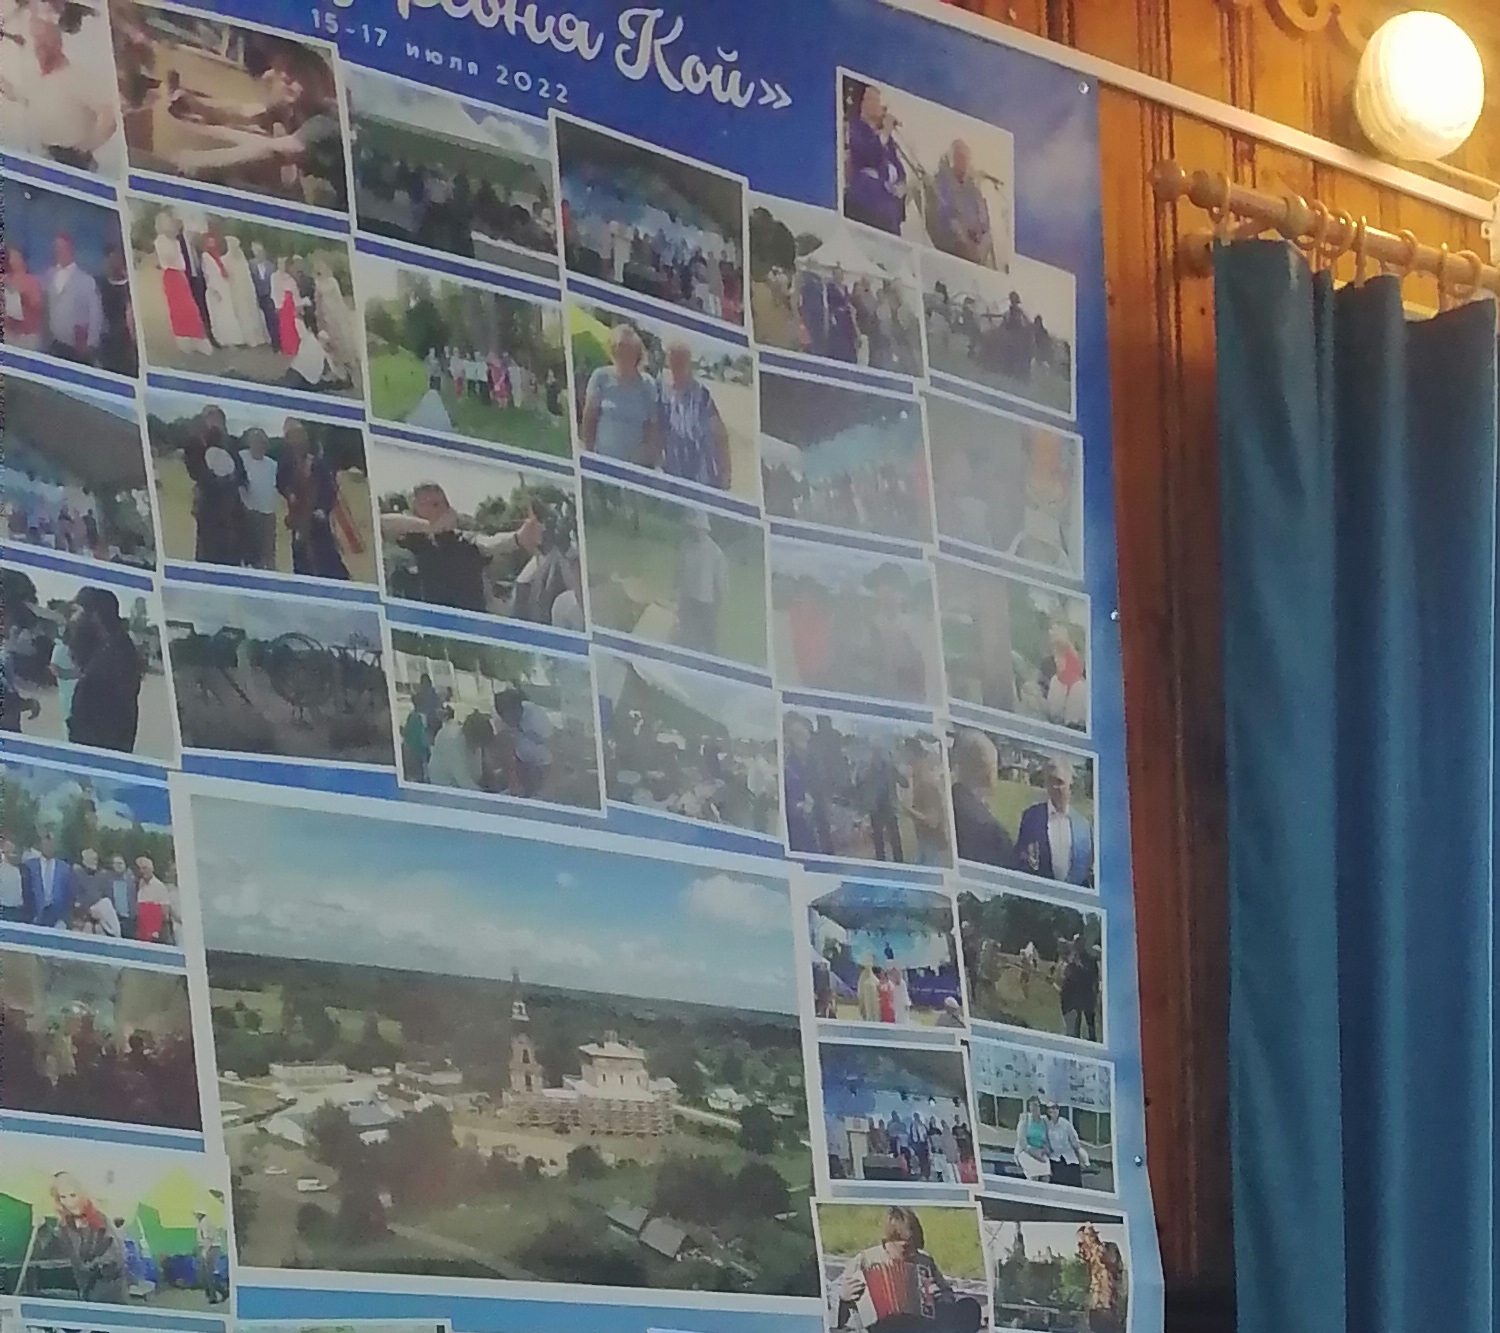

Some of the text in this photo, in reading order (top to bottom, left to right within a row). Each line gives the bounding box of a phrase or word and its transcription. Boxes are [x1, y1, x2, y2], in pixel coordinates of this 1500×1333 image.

[311, 9, 569, 103] 15-17 июля 2022
[615, 7, 792, 109] Кой»
